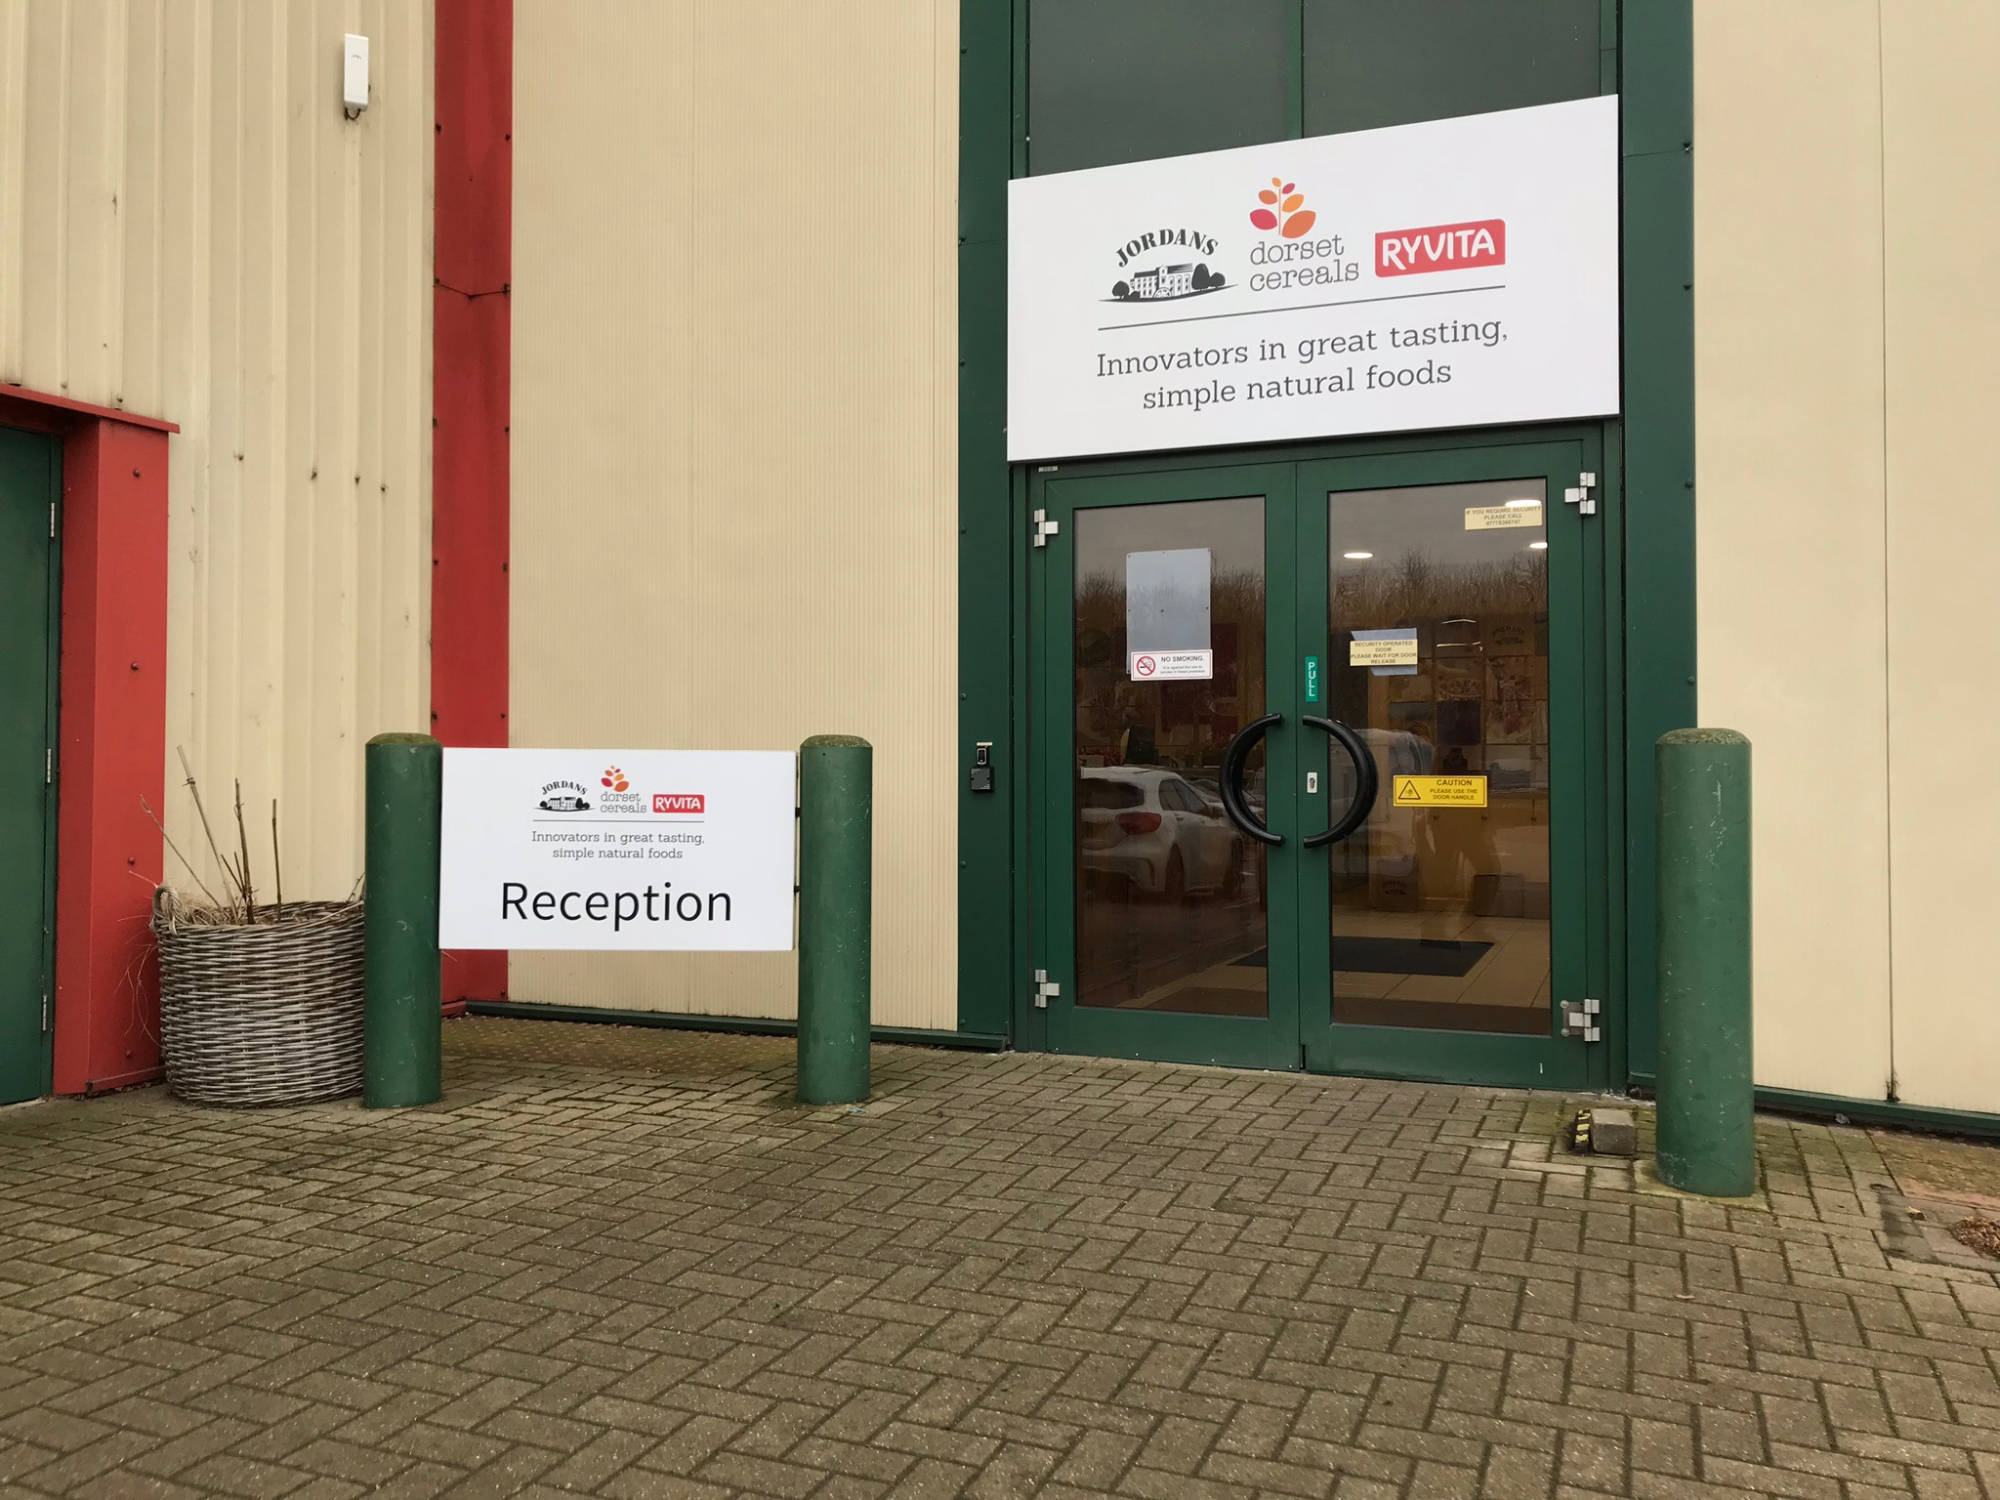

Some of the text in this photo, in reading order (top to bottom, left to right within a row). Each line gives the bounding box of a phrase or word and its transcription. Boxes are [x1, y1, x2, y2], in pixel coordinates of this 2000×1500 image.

[1116, 228, 1218, 268] JORDANS
[1250, 234, 1344, 266] dorset
[1382, 228, 1496, 270] RYVITA
[1250, 259, 1360, 292] cereals
[1097, 319, 1508, 377] Innovators in great tasting,
[1142, 360, 1452, 412] simple natural foods
[1308, 662, 1316, 697] PULL
[541, 780, 588, 795] JORDANS
[600, 792, 641, 802] dorset
[600, 802, 647, 814] cereals
[655, 797, 701, 811] RYVITA
[532, 831, 600, 843] Innovators
[604, 832, 616, 843] in
[620, 832, 654, 846] great
[553, 848, 682, 861] simple natural foods
[502, 882, 731, 931] Reception
